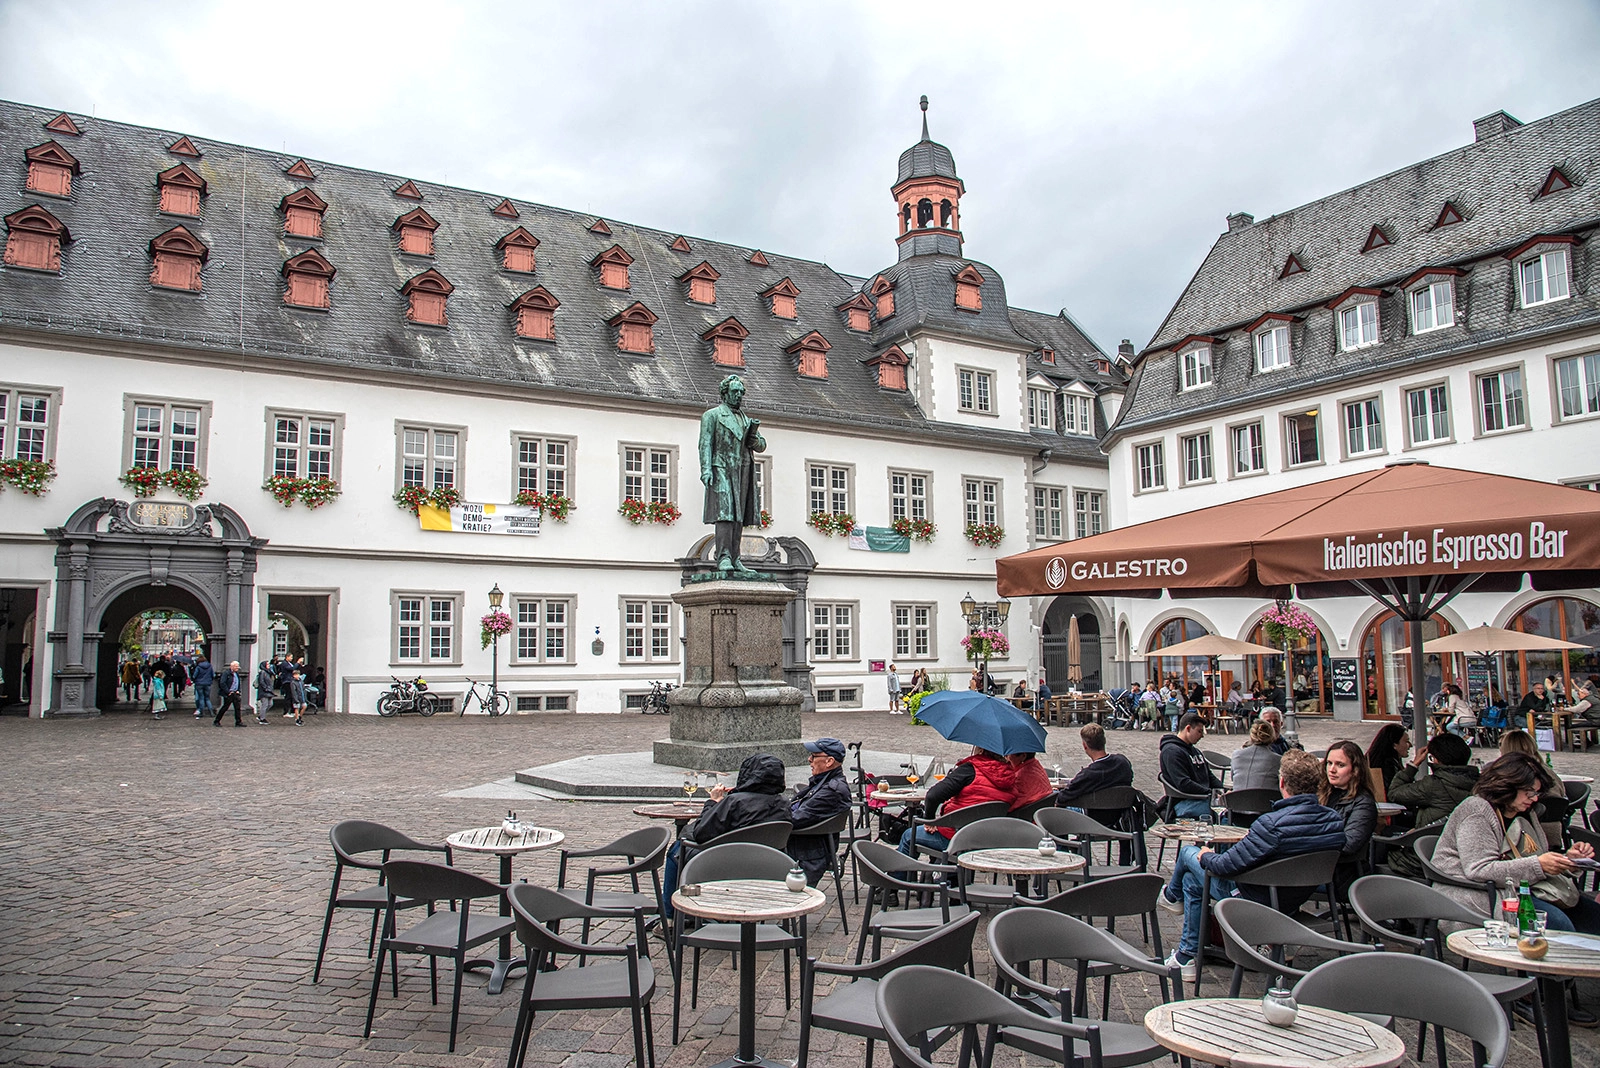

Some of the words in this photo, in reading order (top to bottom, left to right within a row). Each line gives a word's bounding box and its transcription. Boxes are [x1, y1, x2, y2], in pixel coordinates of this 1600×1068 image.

[463, 504, 483, 513] WOZU
[462, 522, 492, 532] KRATIE?
[1323, 531, 1427, 571] Italienische
[1432, 528, 1523, 570] Espresso
[1529, 521, 1568, 559] Bar
[1070, 557, 1188, 581] GALESTRO
